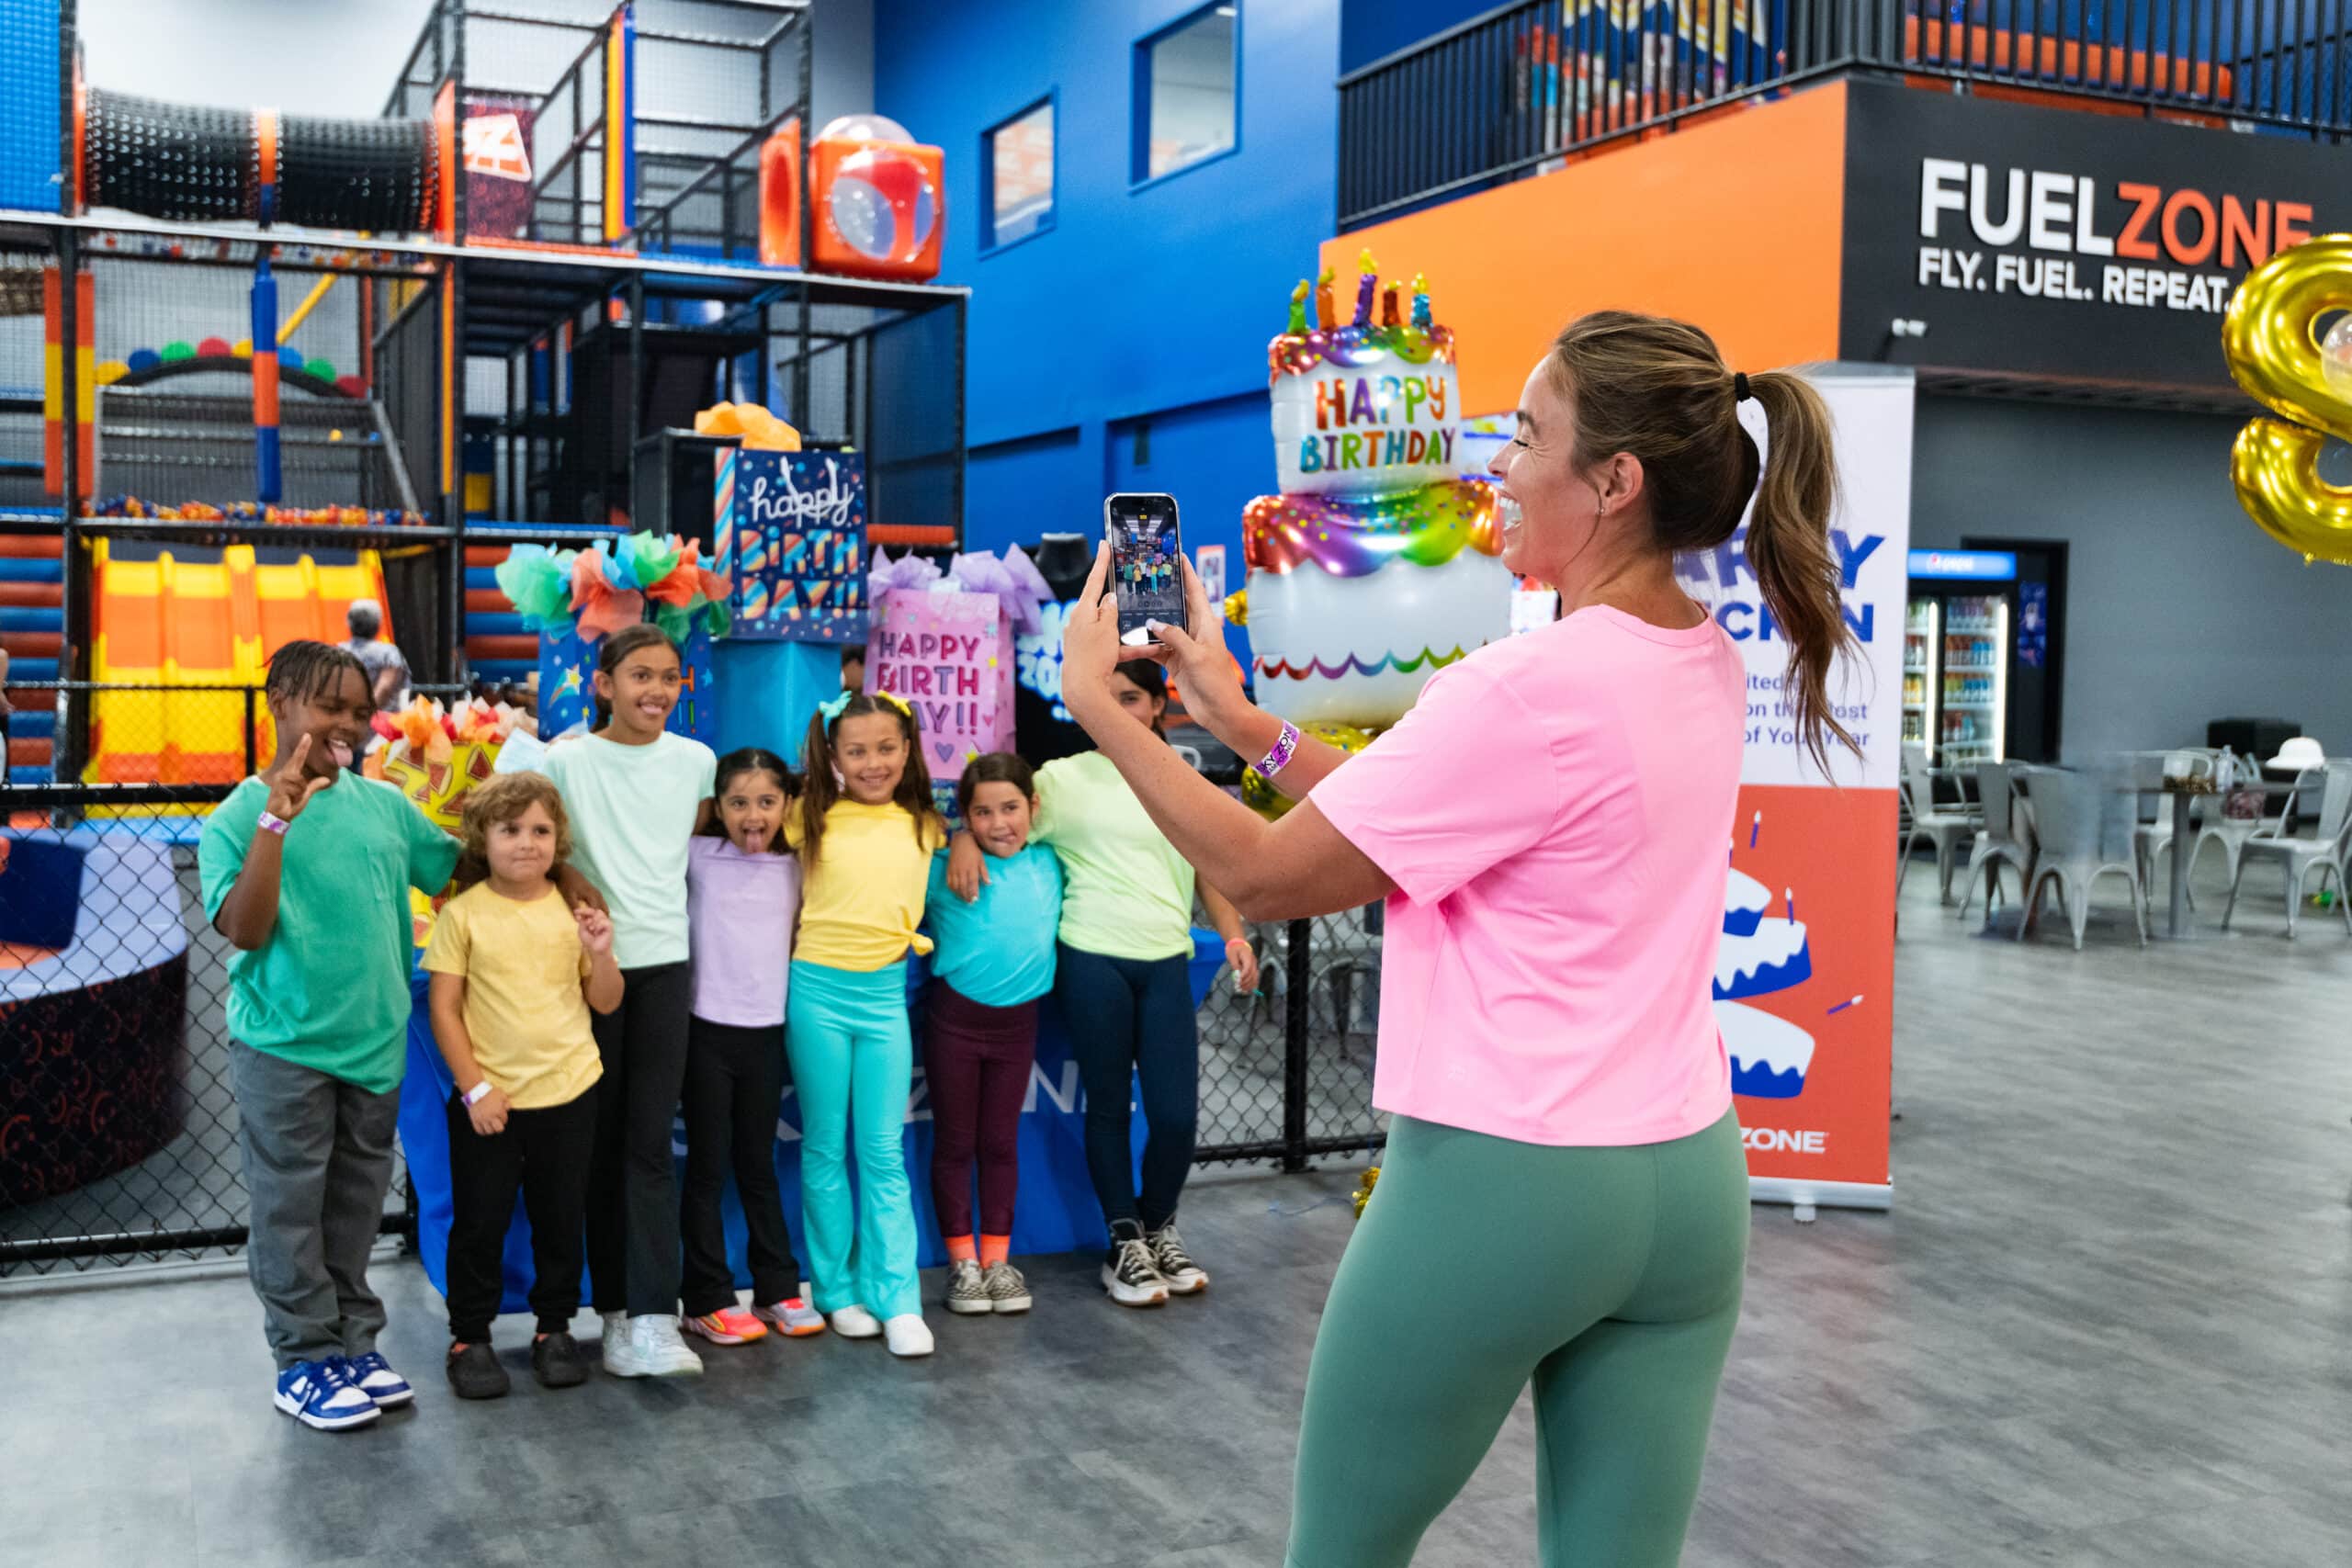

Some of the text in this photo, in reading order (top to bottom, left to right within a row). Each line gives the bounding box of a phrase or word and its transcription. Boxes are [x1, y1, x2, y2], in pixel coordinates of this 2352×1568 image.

[1918, 247, 2230, 313] FLY. FUEL. REPEAT.
[1313, 375, 1448, 430] HAPPY
[1300, 428, 1456, 473] BIRTHDAY
[748, 476, 855, 529] happy
[741, 576, 859, 622] DAY!!
[878, 631, 980, 661] HAPPY
[877, 662, 979, 696] BIRTH
[1747, 673, 1783, 690] ited
